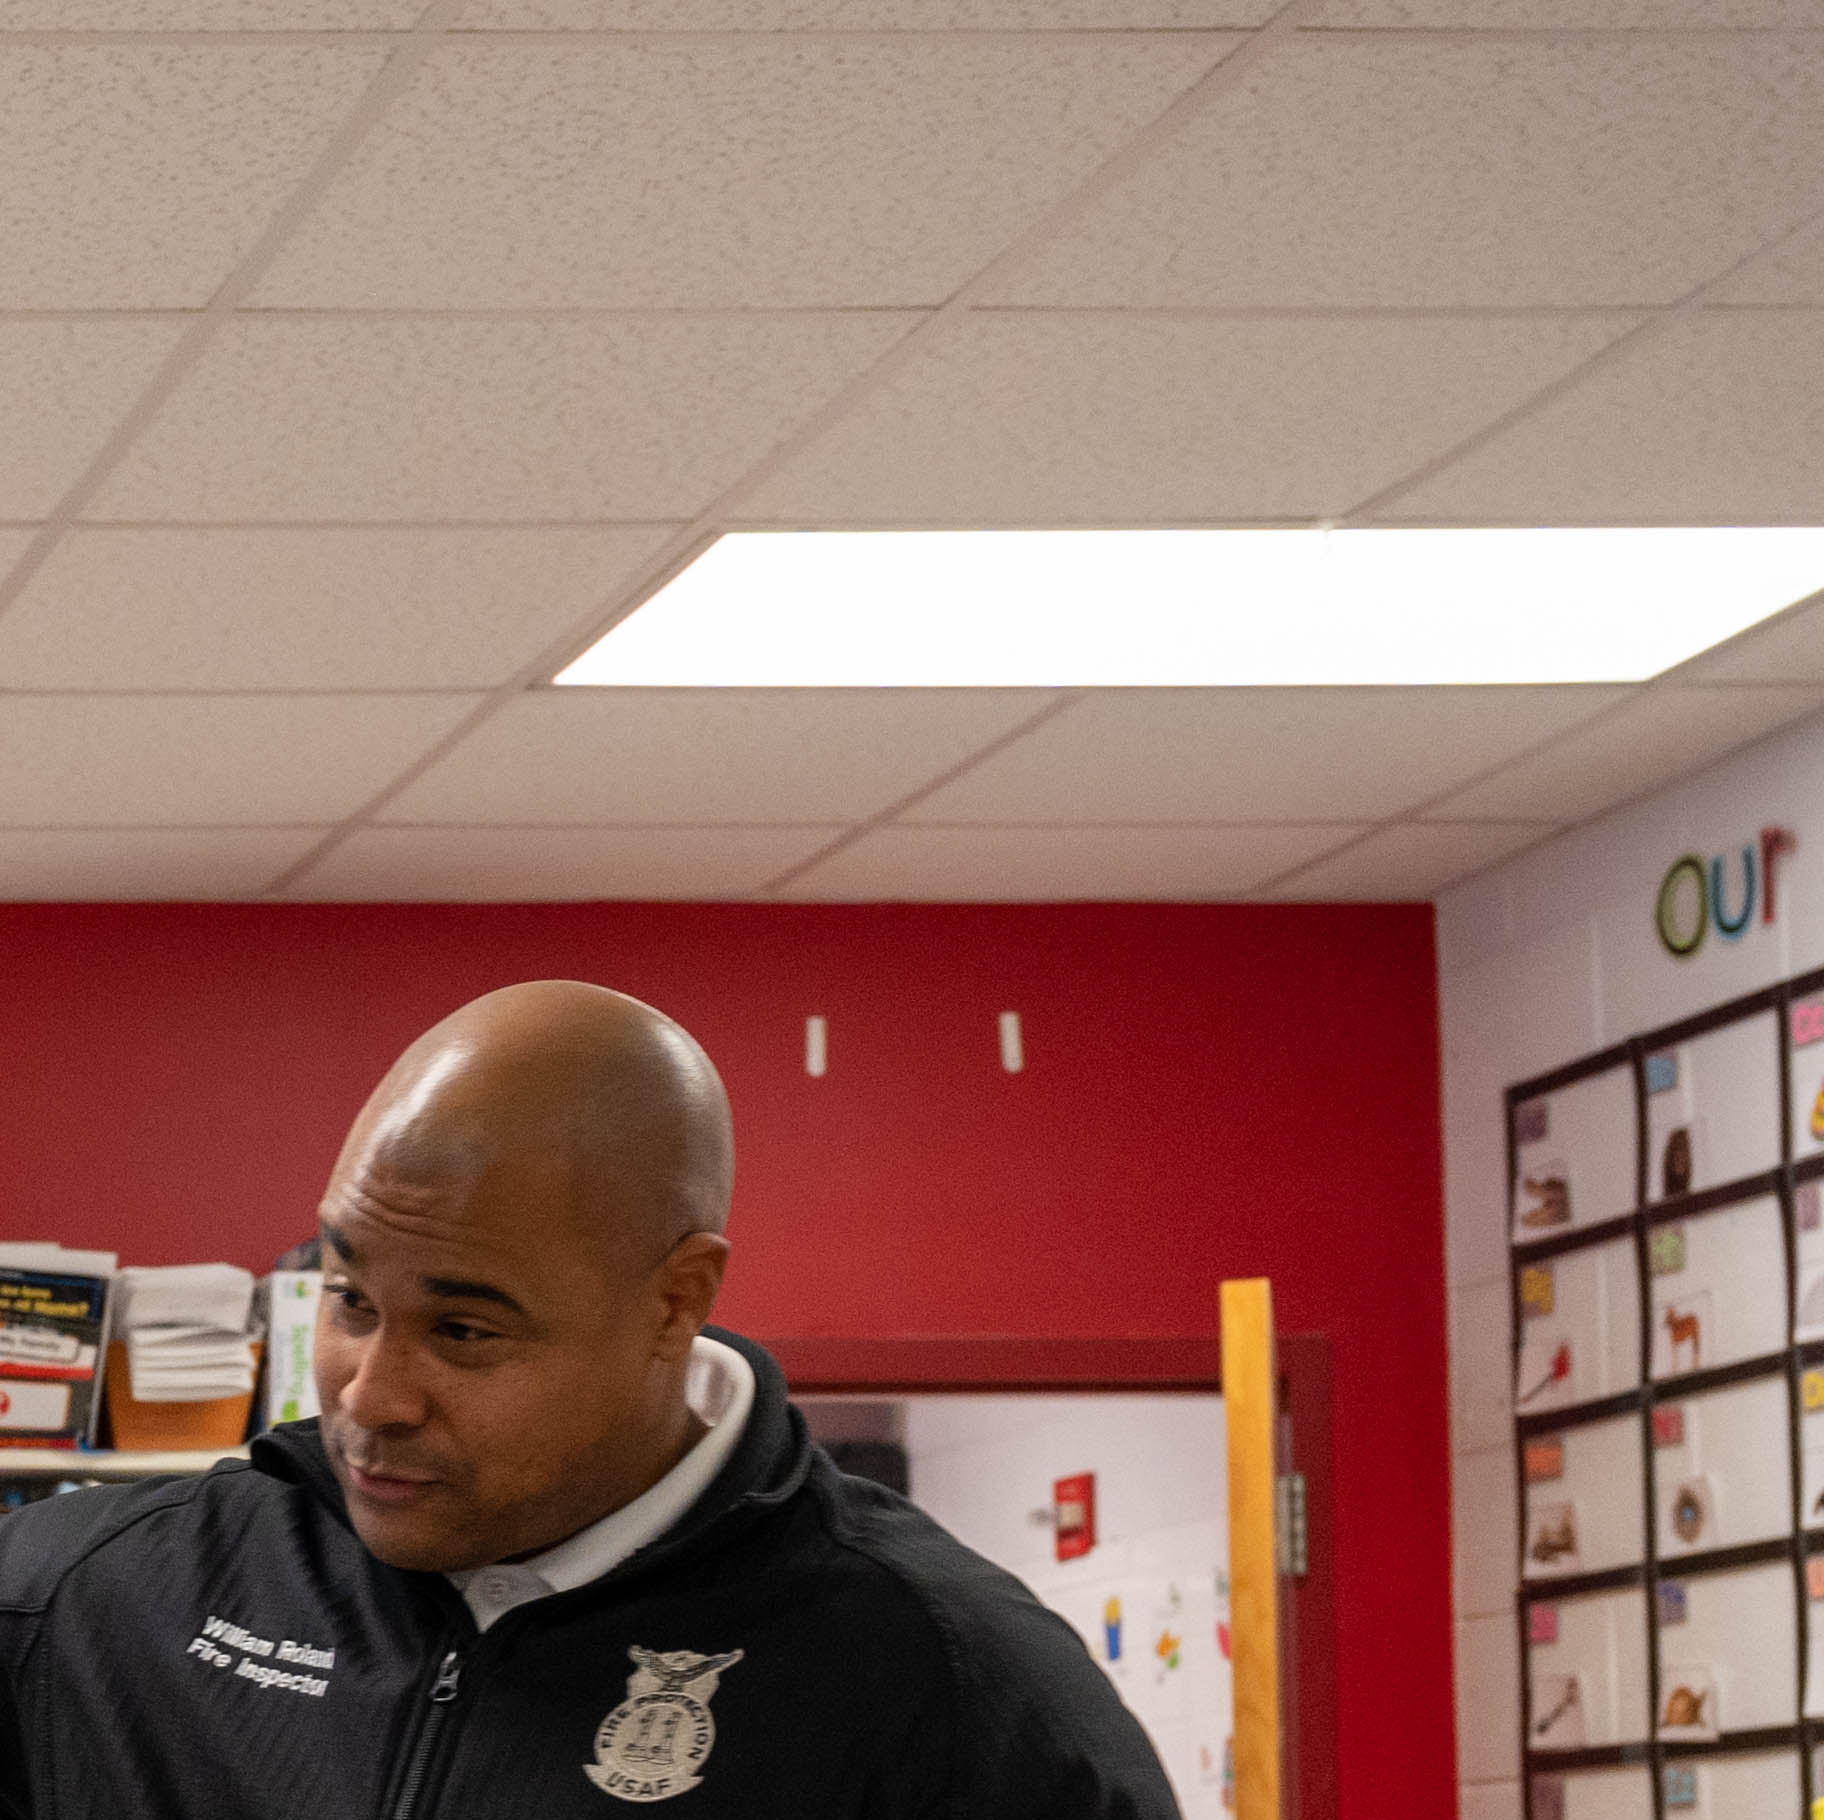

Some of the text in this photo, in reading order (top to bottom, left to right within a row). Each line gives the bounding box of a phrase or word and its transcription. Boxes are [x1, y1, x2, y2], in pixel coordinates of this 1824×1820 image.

[186, 1638, 232, 1667] Fire
[601, 1708, 631, 1749] FIRE
[605, 1770, 671, 1794] USAF
